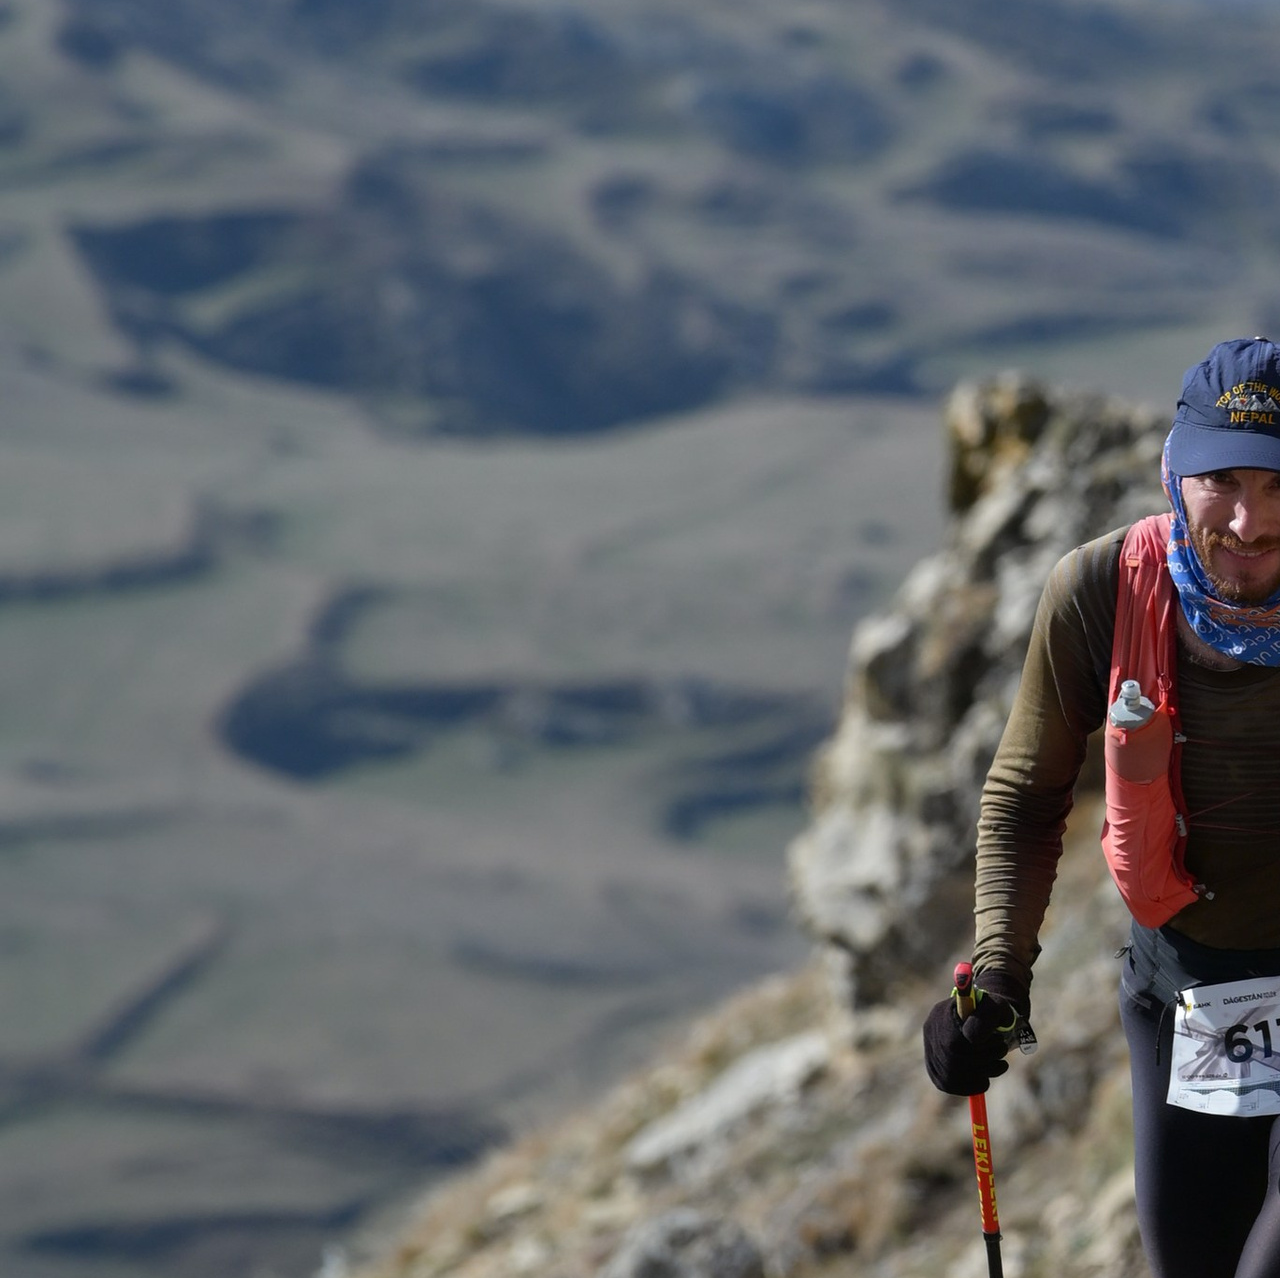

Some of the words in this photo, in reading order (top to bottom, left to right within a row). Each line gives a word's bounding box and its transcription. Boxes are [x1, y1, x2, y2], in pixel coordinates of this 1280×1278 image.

[1215, 391, 1232, 408] TOP
[1232, 383, 1246, 395] OF
[1246, 381, 1269, 393] THE
[1230, 411, 1277, 425] NEPAL
[973, 1123, 990, 1172] LEKI
